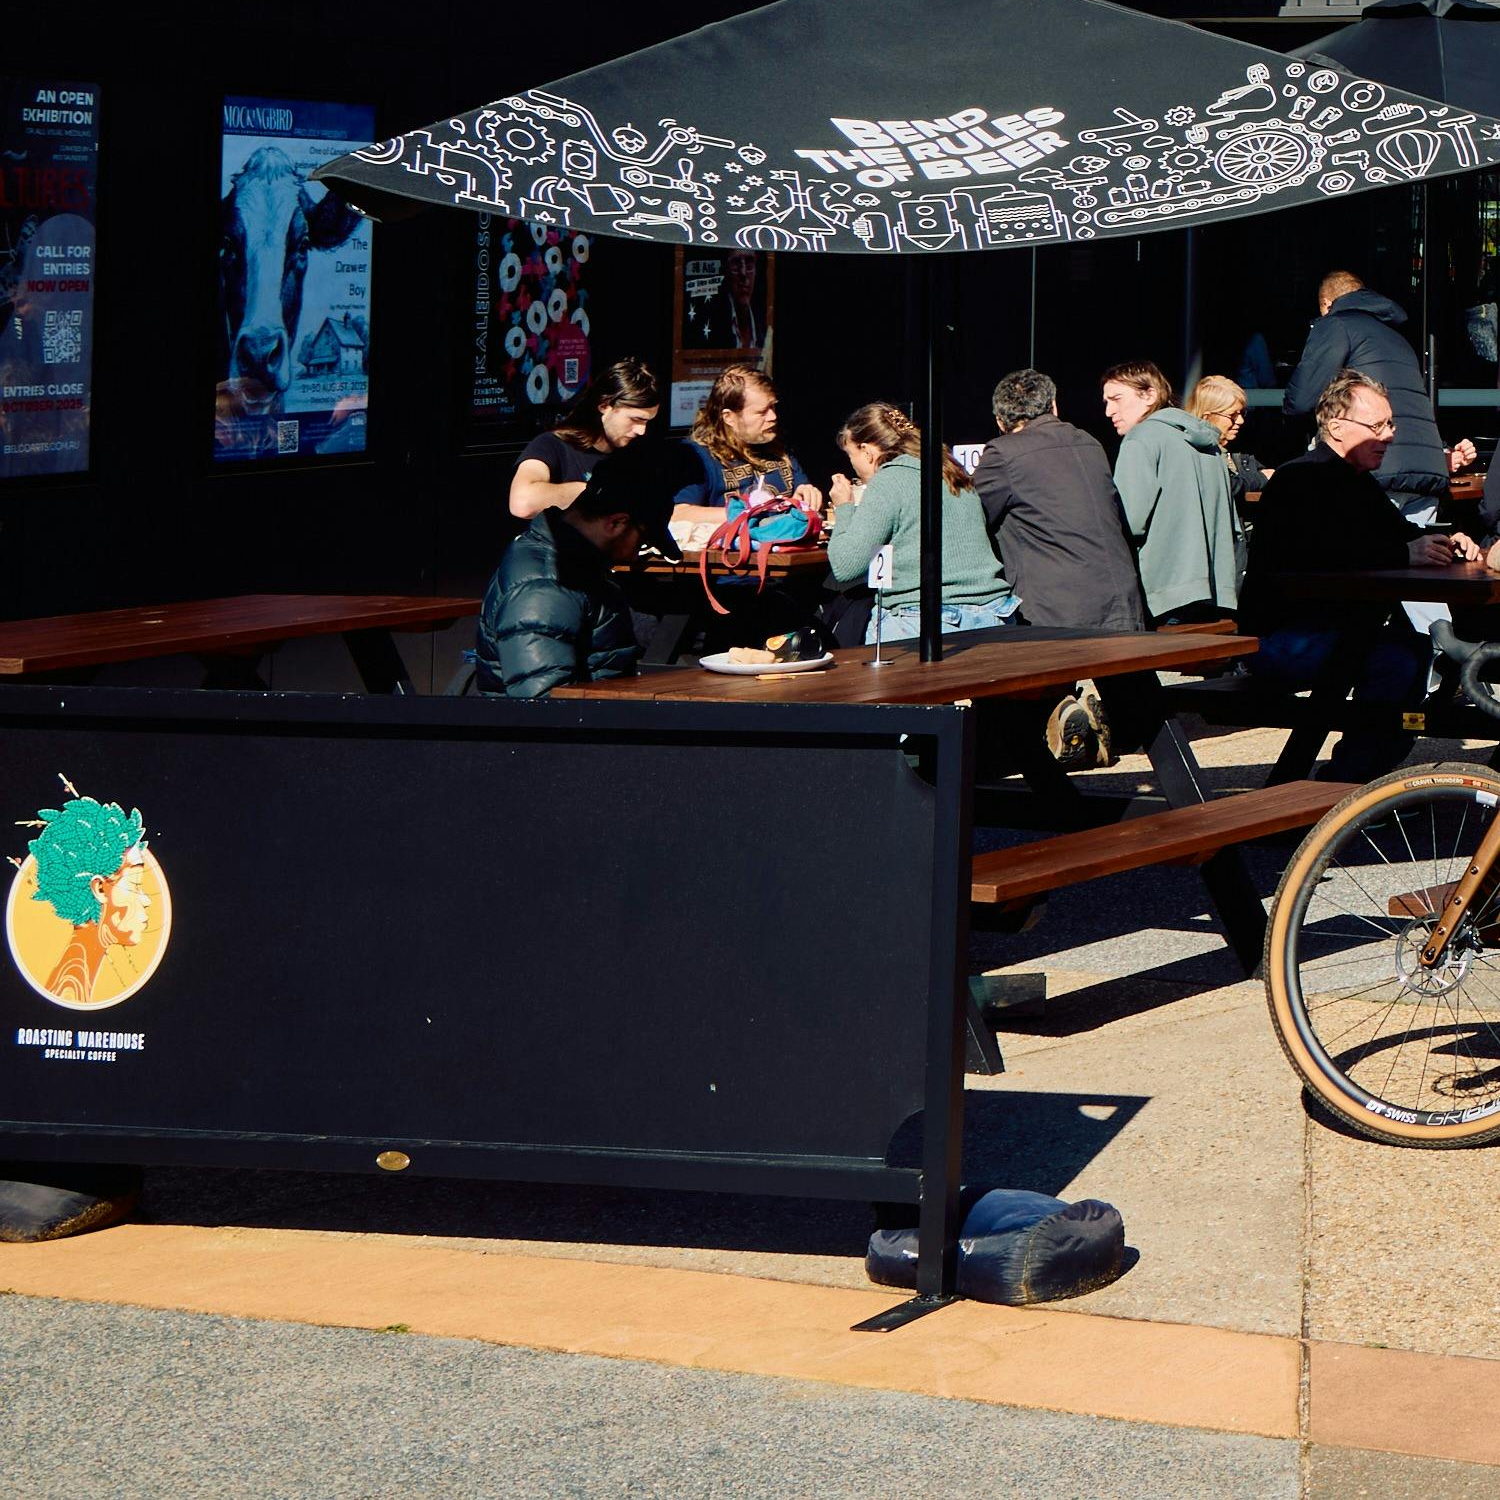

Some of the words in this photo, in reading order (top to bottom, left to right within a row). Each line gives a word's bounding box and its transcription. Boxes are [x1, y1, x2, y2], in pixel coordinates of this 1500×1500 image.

[36, 89, 56, 104] AN
[59, 90, 94, 106] OPEN
[23, 108, 92, 125] EXHIBITION
[223, 105, 294, 132] MOCKINGBIRD
[830, 107, 988, 148] BEND
[794, 148, 906, 174] THE
[907, 106, 1065, 164] RULES
[855, 163, 915, 188] OF
[917, 130, 1071, 181] BEER
[36, 246, 66, 258] CALL
[67, 246, 91, 258] FOR
[352, 238, 368, 251] The
[43, 263, 91, 275] ENTRIES
[335, 261, 367, 274] Drawer
[27, 280, 57, 293] NOW
[58, 280, 90, 292] OPEN
[349, 283, 366, 299] Boy
[3, 385, 45, 398] ENTRIES
[47, 383, 84, 396] CLOSE
[960, 449, 981, 469] 10
[876, 552, 884, 580] 2
[17, 1027, 73, 1047] ROASTING
[77, 1030, 145, 1050] WAREHOUSE
[44, 1048, 86, 1060] SPECIALTY
[87, 1050, 117, 1062] COFFEE
[1365, 1100, 1386, 1115] DT
[1385, 1107, 1418, 1125] SWISS
